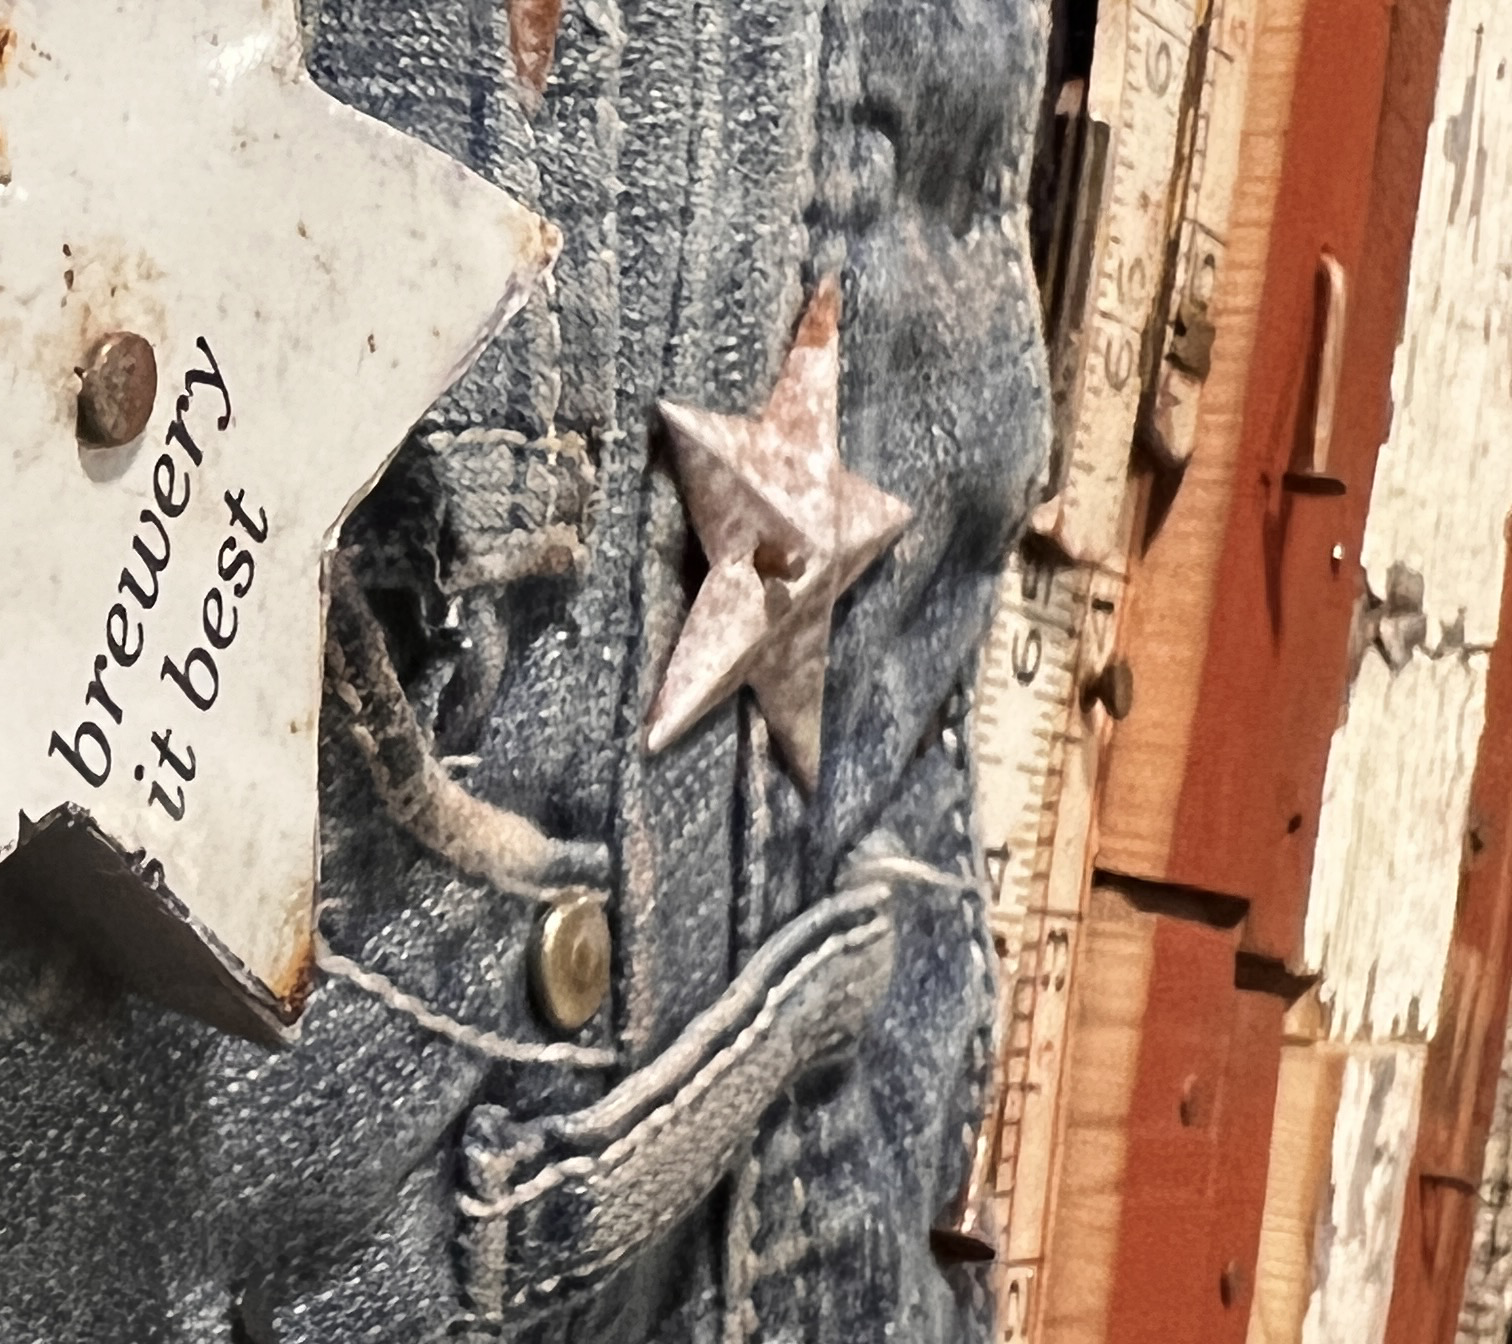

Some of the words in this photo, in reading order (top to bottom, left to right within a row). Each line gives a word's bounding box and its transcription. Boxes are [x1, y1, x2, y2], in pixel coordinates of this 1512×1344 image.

[49, 335, 232, 789] brewery
[159, 488, 269, 712] best
[133, 728, 197, 822] it
